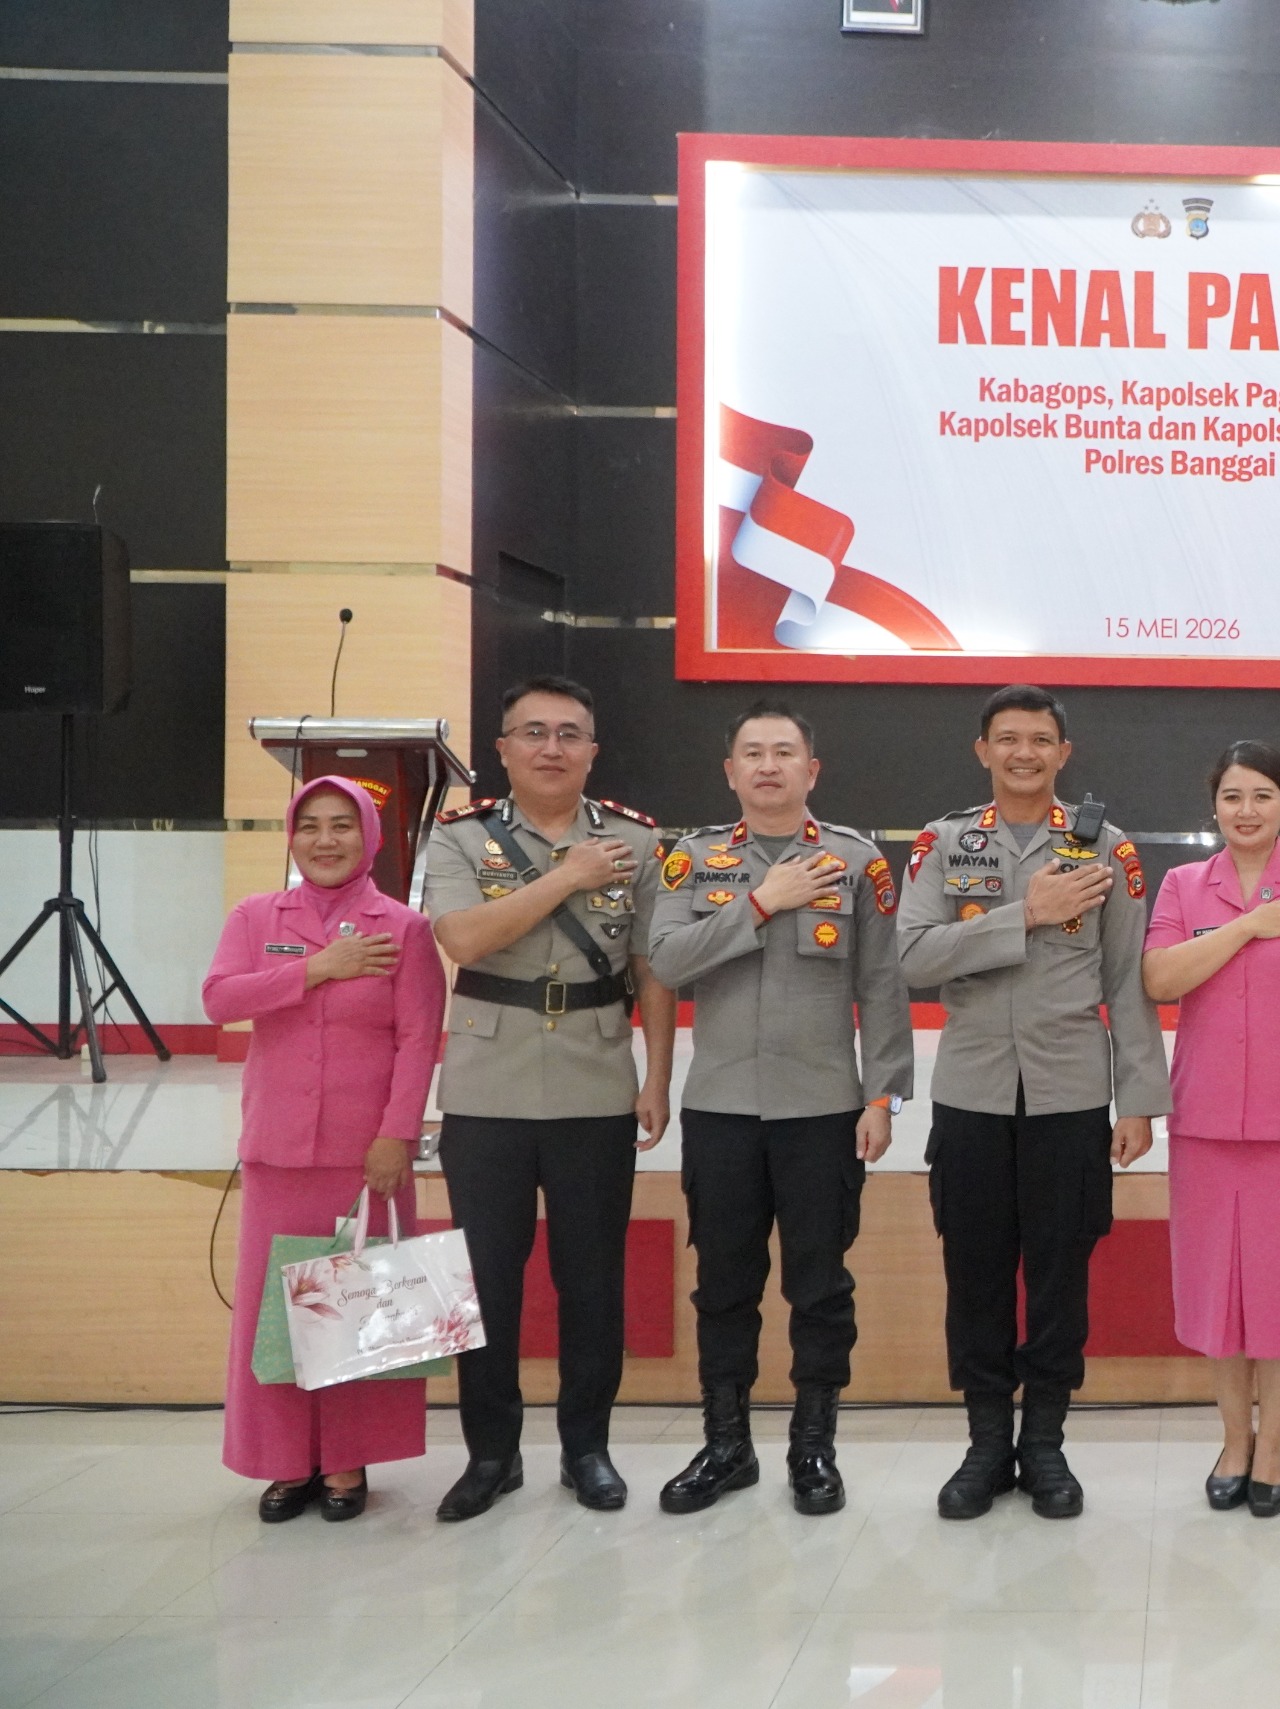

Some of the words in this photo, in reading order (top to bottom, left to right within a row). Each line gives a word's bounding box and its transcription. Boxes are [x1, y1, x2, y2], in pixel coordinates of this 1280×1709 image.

[939, 266, 1166, 348] KENAL
[980, 378, 1113, 409] Kabagops,
[1122, 381, 1239, 411] Kapolsek
[939, 411, 1057, 442] Kapolsek
[1065, 414, 1141, 439] Bunta
[1148, 416, 1196, 441] dan
[1085, 449, 1164, 475] Polres
[1171, 450, 1276, 482] Banggai
[1104, 617, 1131, 638] 15
[1138, 618, 1178, 639] MEI
[1186, 618, 1240, 641] 2026
[353, 780, 388, 796] ANGGAI
[948, 854, 999, 868] WAYAN
[738, 873, 751, 884] JR
[337, 1287, 379, 1308] Semoga
[376, 1298, 393, 1309] dan
